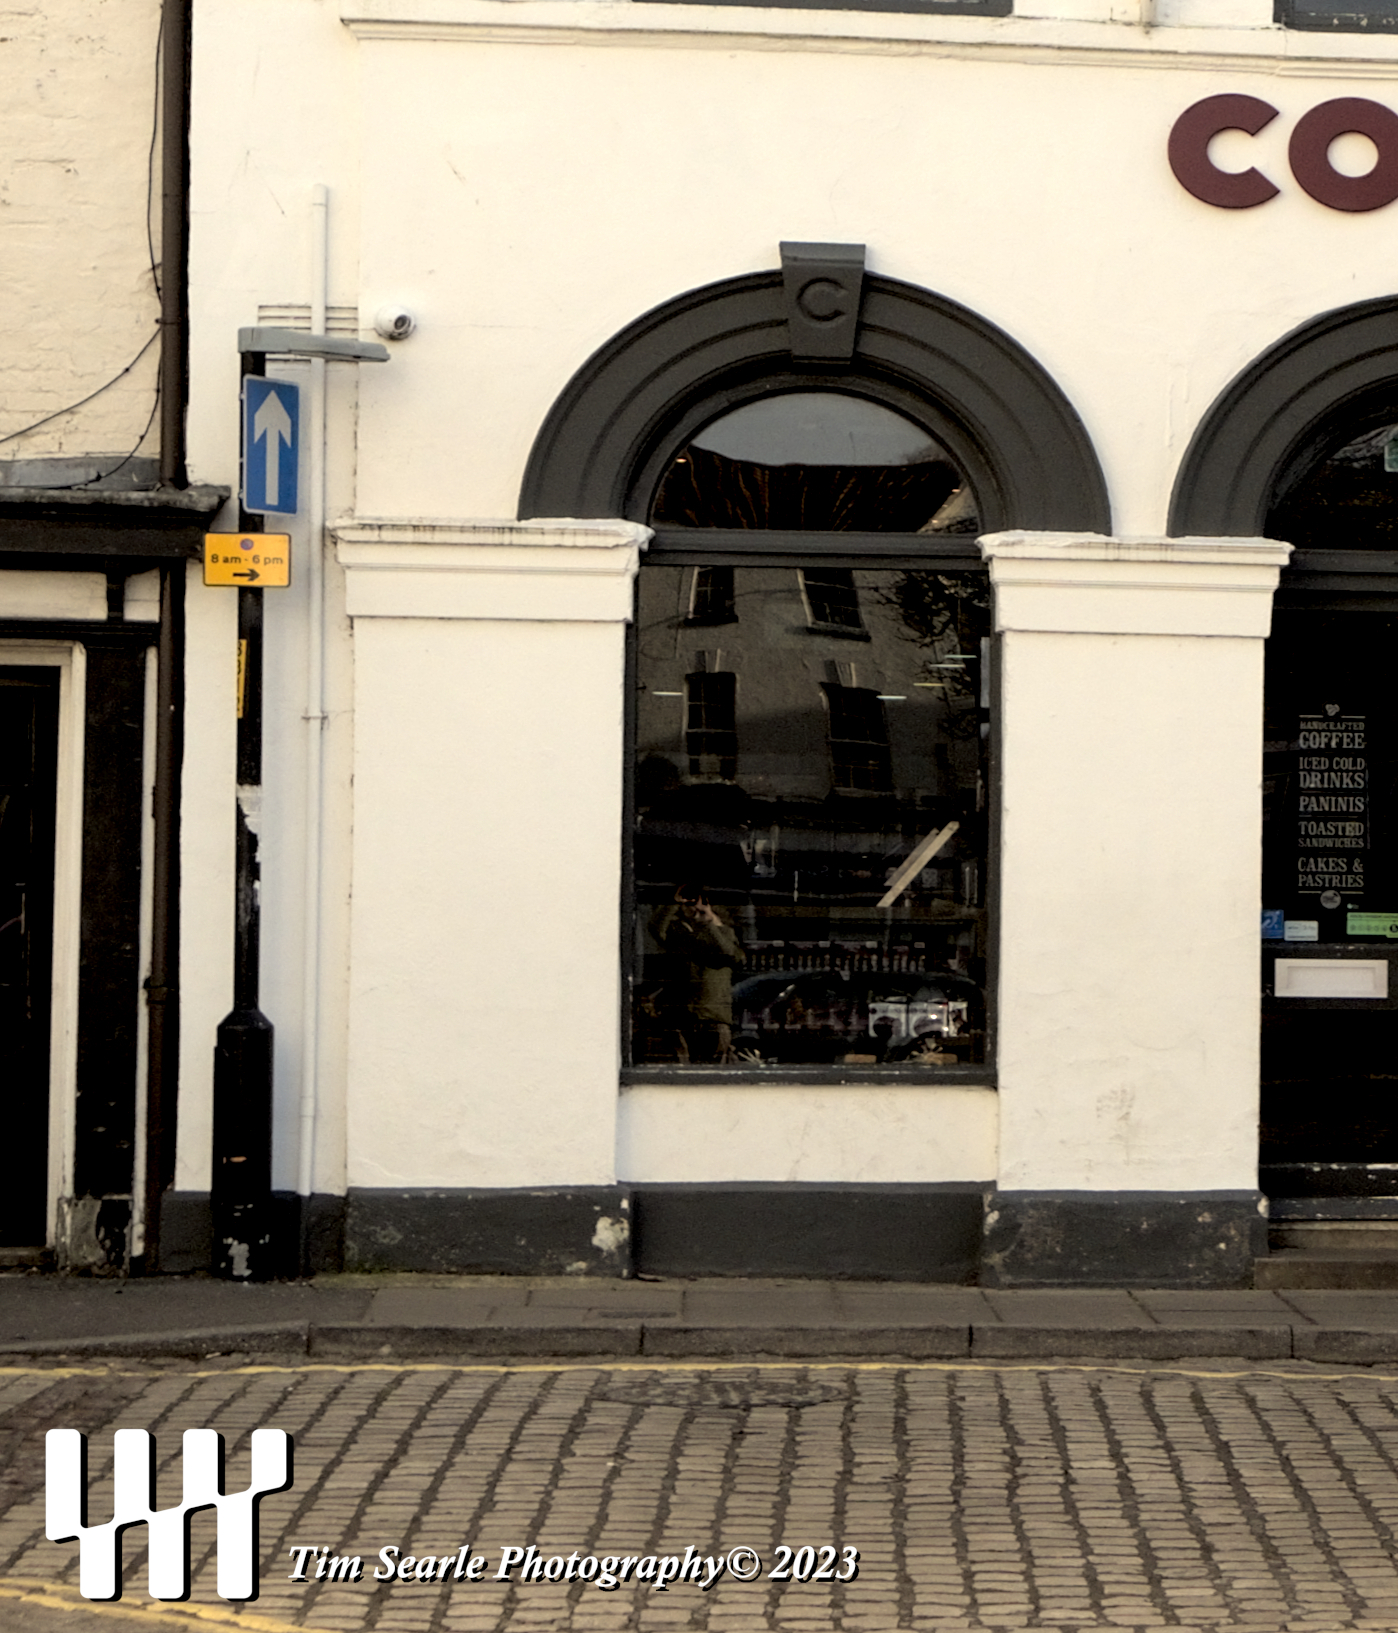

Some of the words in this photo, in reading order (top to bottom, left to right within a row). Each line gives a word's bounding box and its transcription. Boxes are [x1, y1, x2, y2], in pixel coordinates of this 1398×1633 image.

[211, 553, 219, 563] 8
[222, 556, 241, 564] am
[252, 554, 260, 564] 6
[263, 556, 283, 566] pm
[1299, 721, 1365, 730] HANDCRAFTED
[1299, 731, 1365, 749] COFFEE
[1299, 757, 1329, 770] ICED
[1332, 757, 1365, 770] COLD
[1298, 771, 1365, 789] DRINKS
[1299, 796, 1365, 812] PANINIS
[1298, 821, 1364, 836] TOASTED
[1298, 838, 1364, 848] SANDWICHES
[1298, 857, 1347, 872] CAKES
[1352, 858, 1364, 872] &
[1298, 874, 1364, 887] PASTRIES
